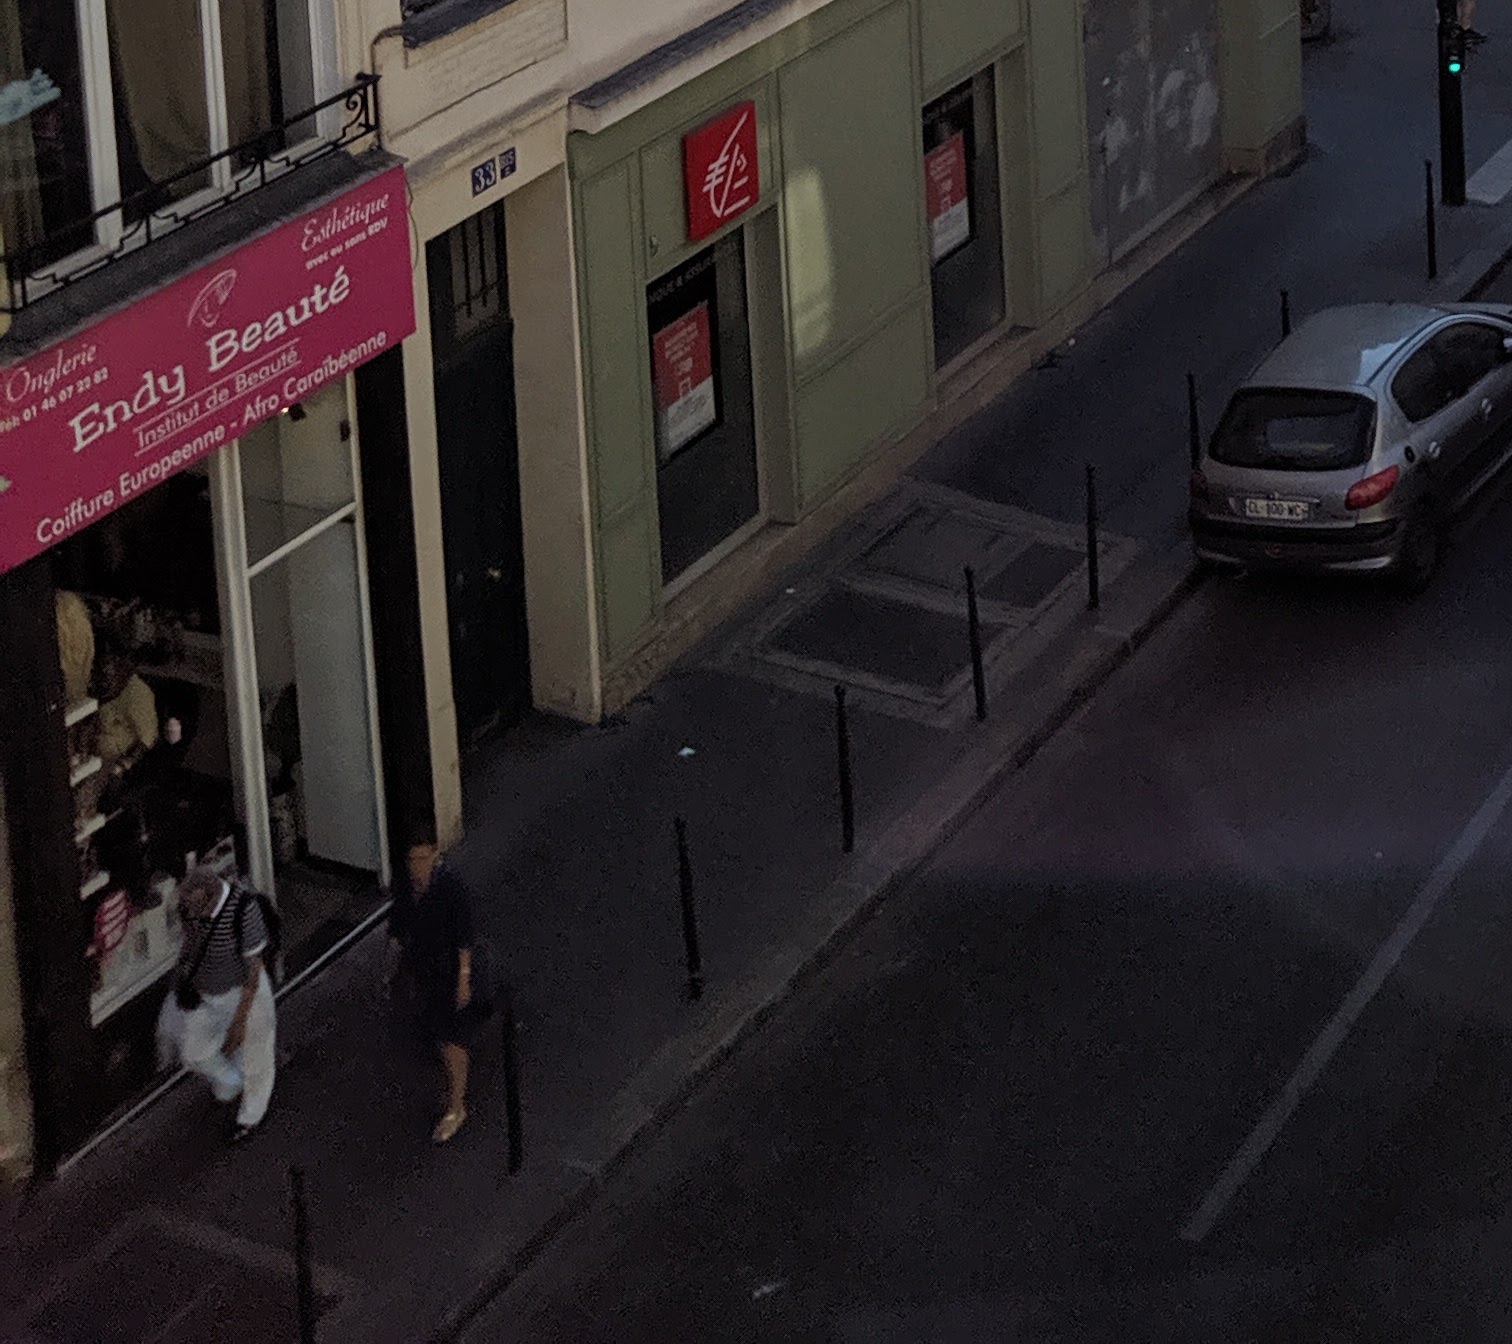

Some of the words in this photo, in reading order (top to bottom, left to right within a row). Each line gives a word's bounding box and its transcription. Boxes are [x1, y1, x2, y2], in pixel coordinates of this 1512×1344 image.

[474, 161, 496, 192] 33
[301, 193, 390, 252] Esthétique
[329, 243, 344, 257] ou
[344, 230, 367, 250] sans
[367, 216, 389, 236] RDV
[6, 343, 98, 403] Onglerie
[68, 363, 186, 453] Endy
[205, 265, 350, 373] Beauté
[22, 404, 38, 422] 01
[136, 404, 200, 449] Institut
[205, 386, 229, 410] de
[235, 348, 299, 393] Beauté
[36, 489, 114, 543] Coiffure
[243, 396, 280, 426] Afro
[283, 329, 388, 401] Caraïbéenne
